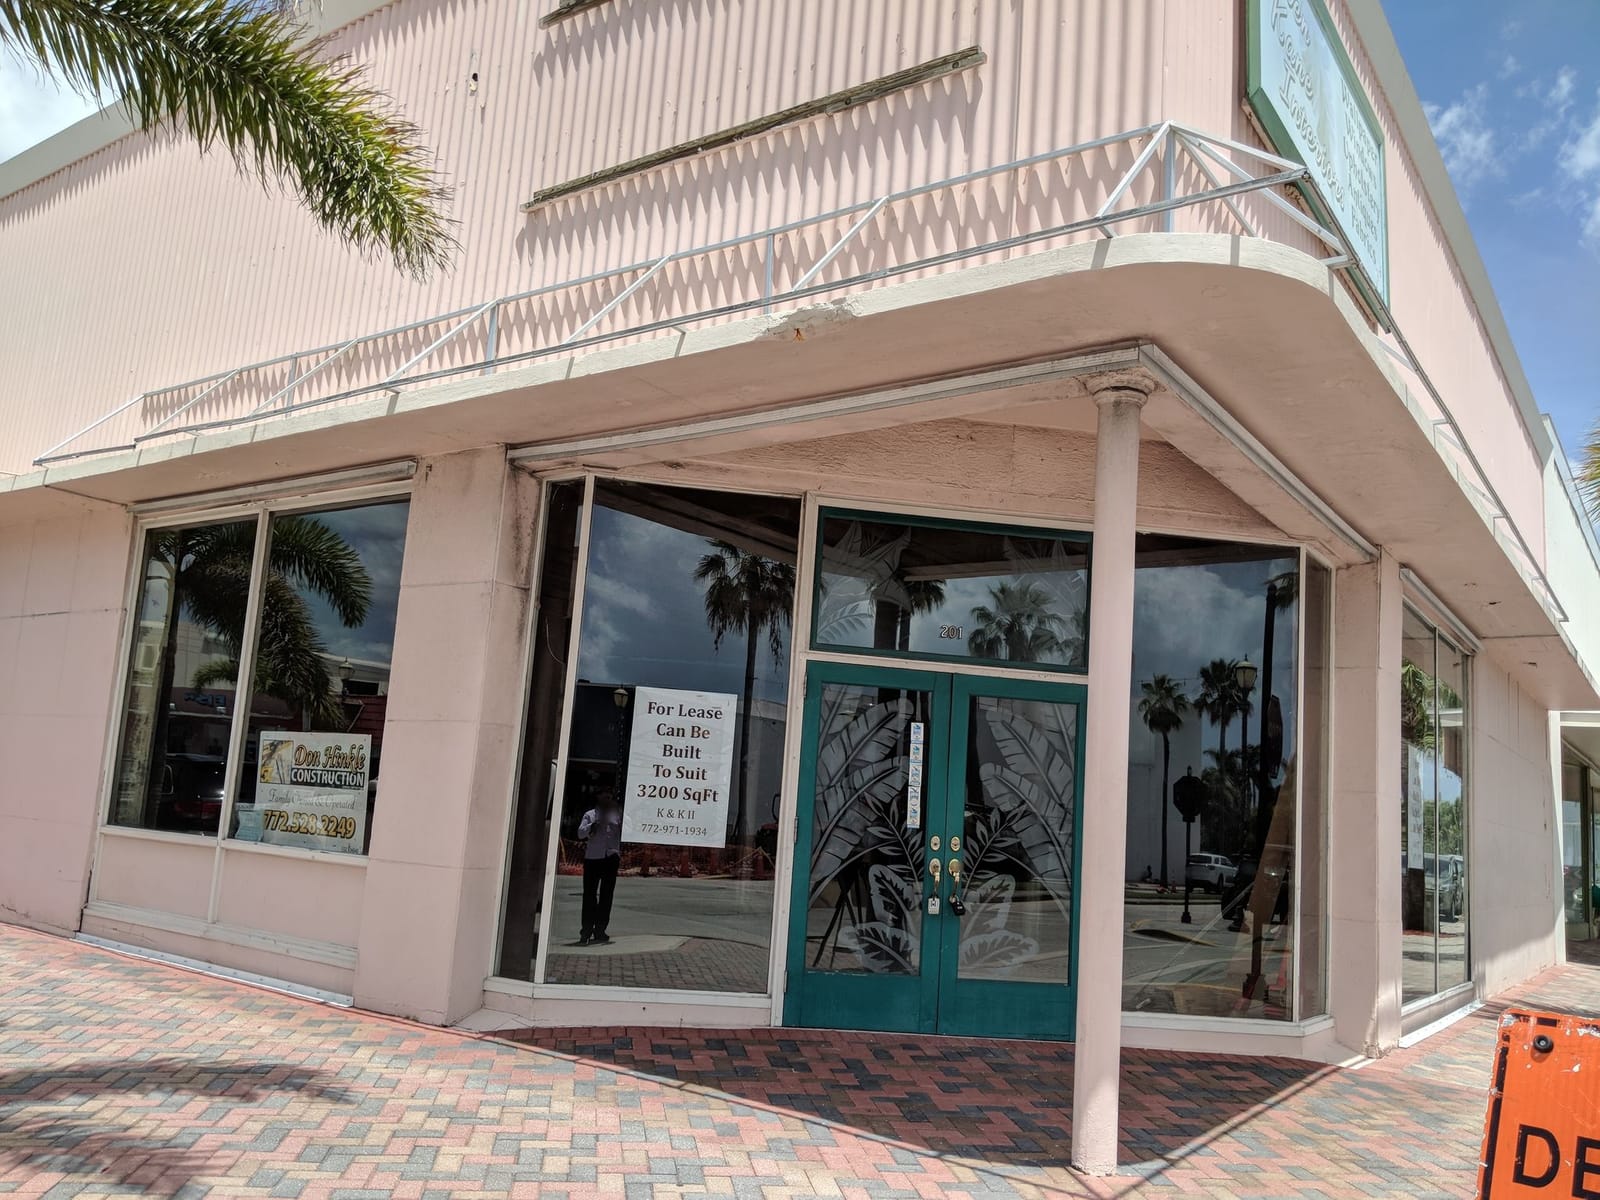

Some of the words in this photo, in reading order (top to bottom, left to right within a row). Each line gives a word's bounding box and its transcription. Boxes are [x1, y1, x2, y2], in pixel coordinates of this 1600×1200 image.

[940, 624, 963, 640] 201
[647, 701, 675, 716] For
[678, 704, 723, 720] Lease
[656, 723, 686, 738] Can
[690, 725, 711, 740] Be
[294, 744, 321, 767] Don
[322, 744, 367, 774] Hinkle
[662, 744, 702, 760] Built
[291, 768, 365, 787] CONSTRUCTION
[652, 764, 672, 778] To
[675, 766, 708, 780] Suit
[637, 784, 679, 800] 3200
[682, 787, 720, 805] SqFt
[657, 808, 665, 818] K
[666, 809, 675, 819] &
[677, 809, 686, 819] K
[264, 809, 357, 840] 772.528.2249
[641, 823, 708, 837] 772-971-1934
[1512, 1123, 1600, 1200] DE
